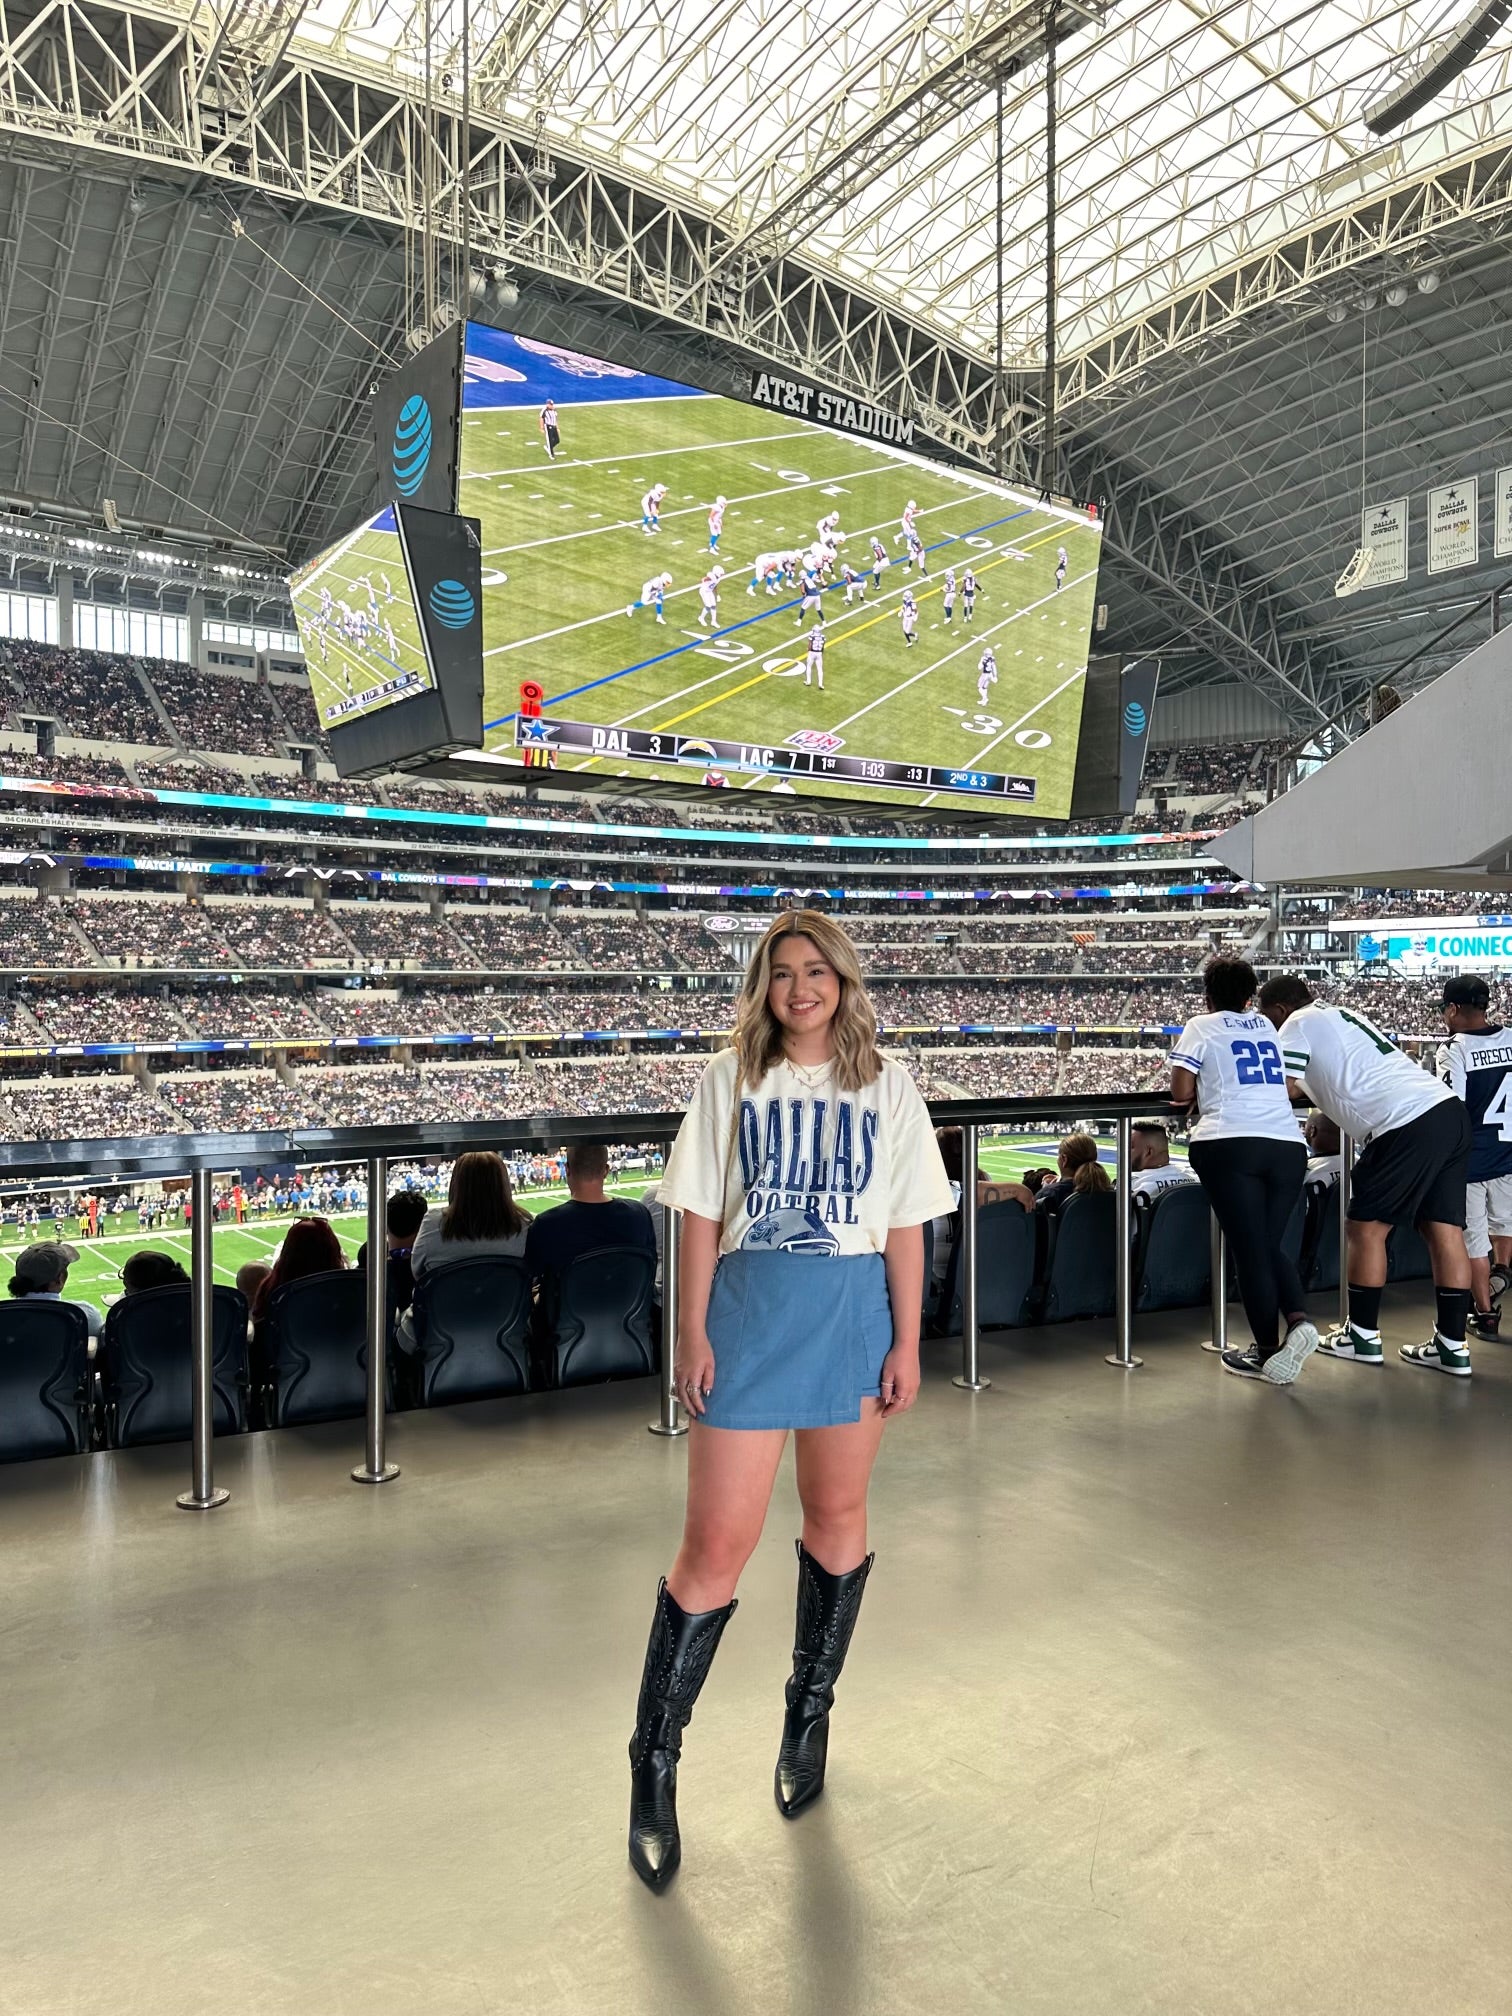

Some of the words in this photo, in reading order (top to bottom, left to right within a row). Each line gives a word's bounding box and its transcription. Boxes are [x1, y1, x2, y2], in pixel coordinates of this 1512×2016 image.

[753, 373, 814, 415] AT&T
[817, 391, 915, 446] STADIUM
[1437, 505, 1468, 519] COWBOYS
[1440, 499, 1465, 511] DALLAS
[1370, 523, 1399, 537] COWBOYS
[1373, 518, 1397, 529] DALLAS
[1433, 524, 1452, 534] SUPER
[1440, 541, 1466, 552] WORLD
[1432, 547, 1474, 562] CHAMPIONS
[1369, 564, 1404, 577] HAMPIONS
[592, 728, 631, 752] DAL
[650, 736, 661, 755] 3
[740, 747, 775, 767] LAC
[789, 752, 797, 769] 7
[821, 757, 836, 771] 1ST
[860, 762, 885, 778] 1:03
[907, 768, 922, 781] :13
[950, 772, 968, 784] 2ND
[970, 775, 978, 786] &
[980, 776, 988, 787] 3
[16, 816, 50, 825] CHARLES
[134, 860, 174, 871] WATCH
[177, 862, 212, 873] PARTY
[381, 872, 396, 881] DAL
[398, 873, 438, 883] COWBOYS
[666, 884, 695, 894] WATCH
[696, 886, 721, 895] PARTY
[1439, 936, 1512, 957] CONNEC
[1231, 1040, 1284, 1085] 22
[1483, 1071, 1512, 1142] 4
[739, 1097, 879, 1198] DALLAS
